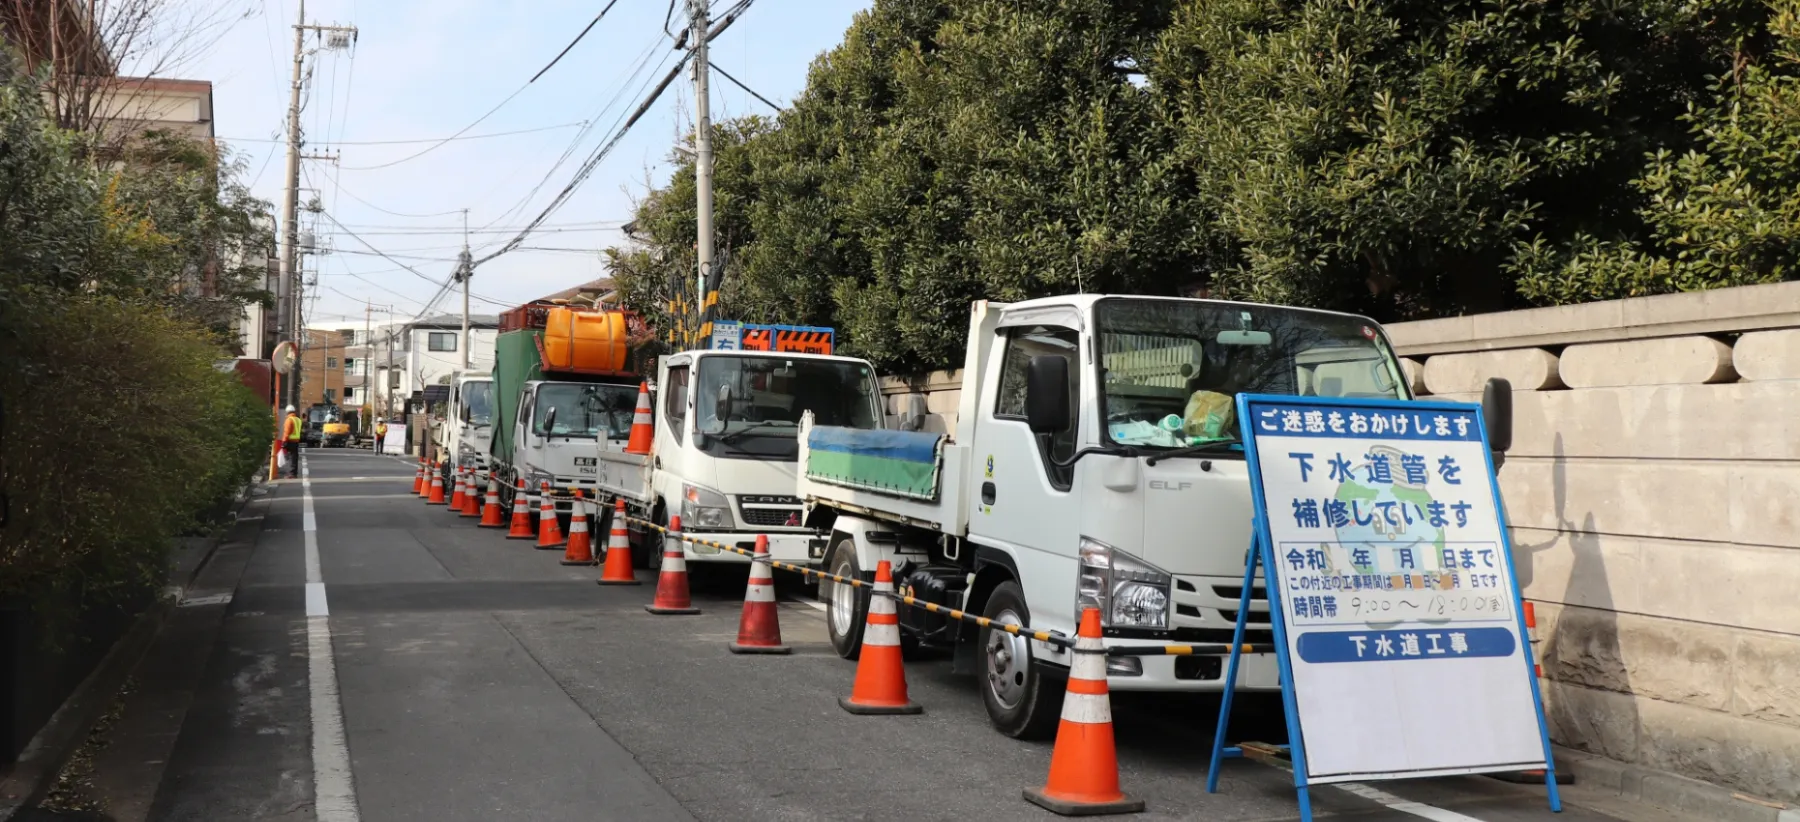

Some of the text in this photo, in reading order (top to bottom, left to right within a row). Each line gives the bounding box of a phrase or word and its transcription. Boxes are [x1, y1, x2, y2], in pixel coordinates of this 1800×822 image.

[1261, 409, 1471, 436] ご迷惑をおかけします
[1288, 452, 1462, 485] 下水道管を
[1149, 480, 1192, 490] ELF
[1291, 498, 1472, 528] 補修しています
[1286, 548, 1494, 570] 令和 年 月 日まで
[1290, 574, 1393, 590] この付近の工事期間は
[1472, 574, 1498, 588] 日です
[1293, 596, 1337, 619] 時間帯
[1348, 632, 1468, 657] 下水道工事
